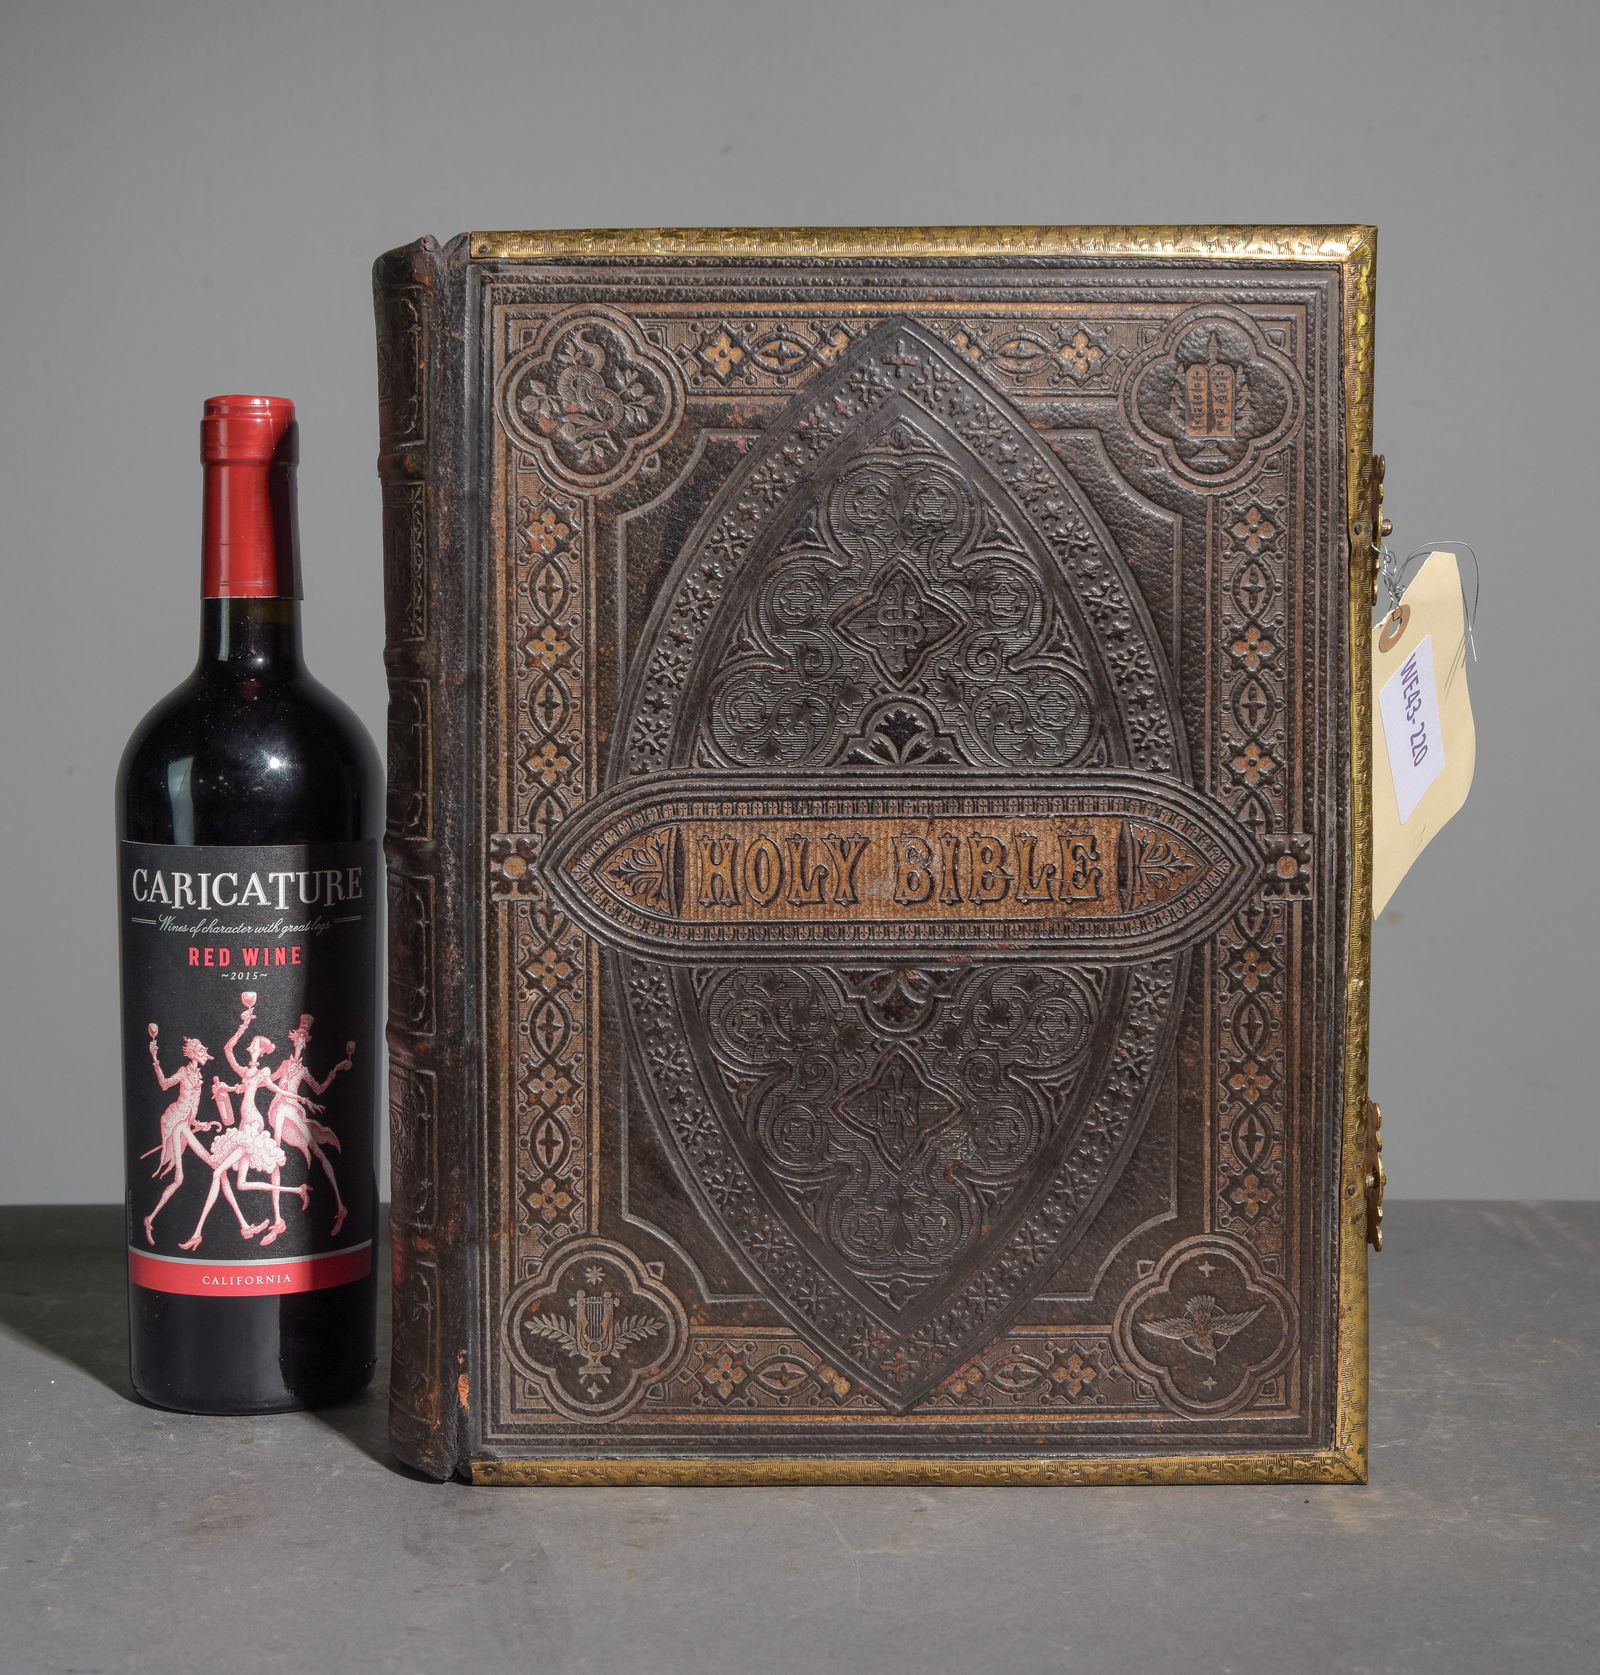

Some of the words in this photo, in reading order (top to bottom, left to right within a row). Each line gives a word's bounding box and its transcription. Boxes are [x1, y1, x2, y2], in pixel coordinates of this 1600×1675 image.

[699, 833, 870, 907] HOLY
[892, 832, 1101, 905] BIBLE
[133, 868, 362, 909] CARICATURE
[158, 914, 189, 932] Wines
[189, 918, 207, 938] of
[201, 918, 254, 934] character
[254, 917, 284, 934] with
[278, 920, 311, 939] great
[188, 946, 231, 967] RED
[242, 946, 302, 966] WINE
[202, 1273, 291, 1286] CALIFORNIA
